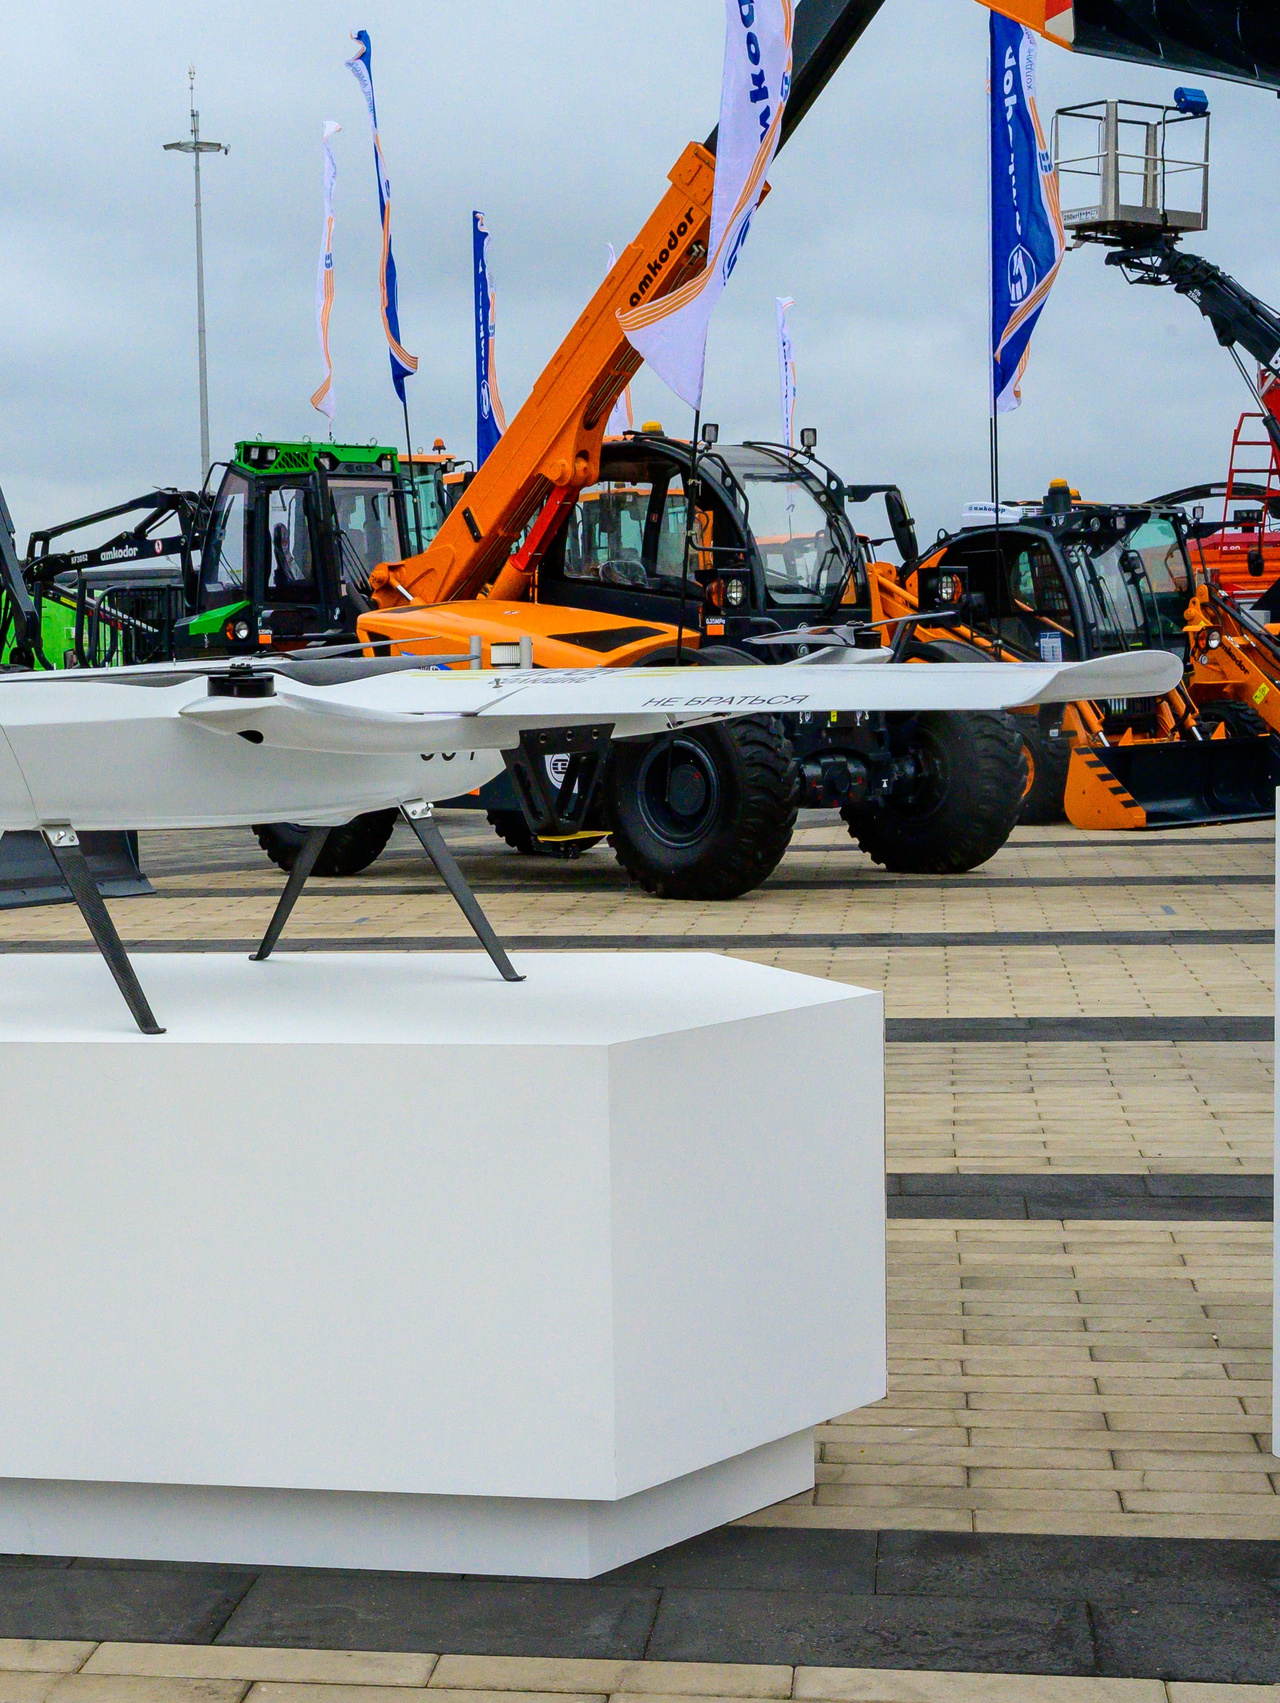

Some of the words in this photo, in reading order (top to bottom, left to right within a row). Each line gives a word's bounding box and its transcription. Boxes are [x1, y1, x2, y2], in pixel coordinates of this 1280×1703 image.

[629, 206, 695, 307] amkodor
[100, 544, 139, 561] amkodor
[642, 697, 684, 707] НЕ
[684, 695, 810, 706] БРАТЬСЯ
